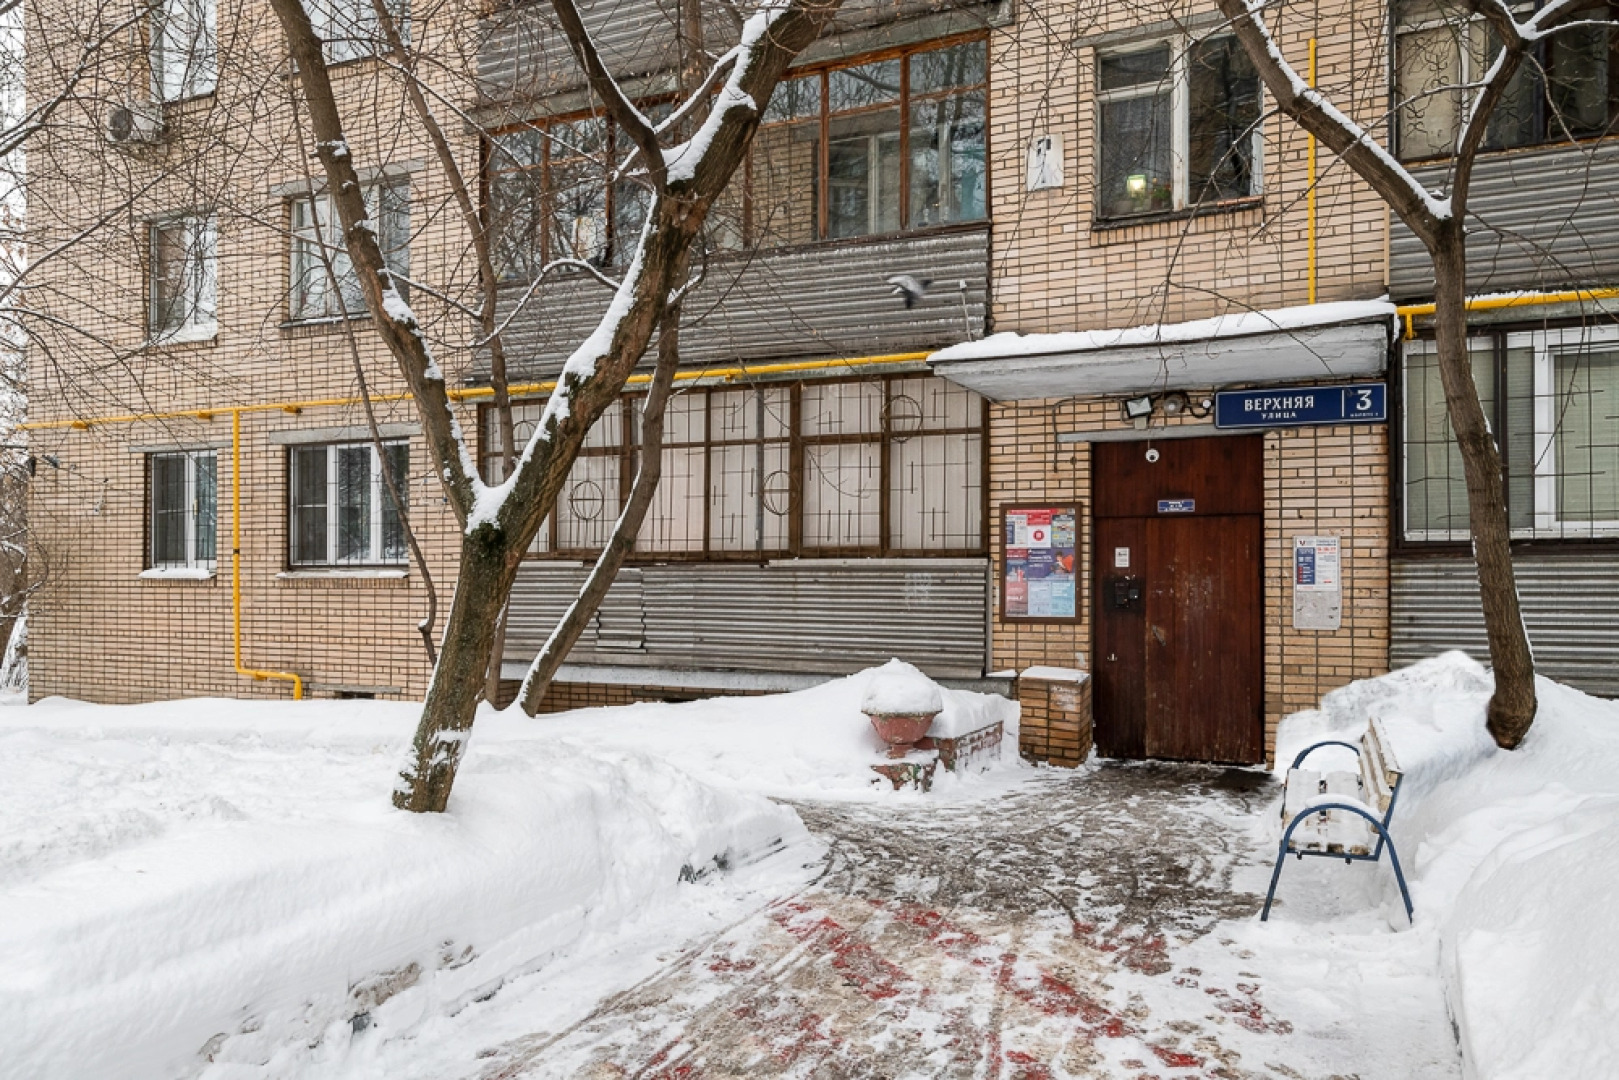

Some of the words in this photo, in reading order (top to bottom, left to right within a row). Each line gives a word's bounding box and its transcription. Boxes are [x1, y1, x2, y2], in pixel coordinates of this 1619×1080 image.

[1244, 395, 1314, 412] ВЕРХНЯЯ
[1356, 389, 1372, 411] 3
[1261, 412, 1297, 420] УЛИЦА
